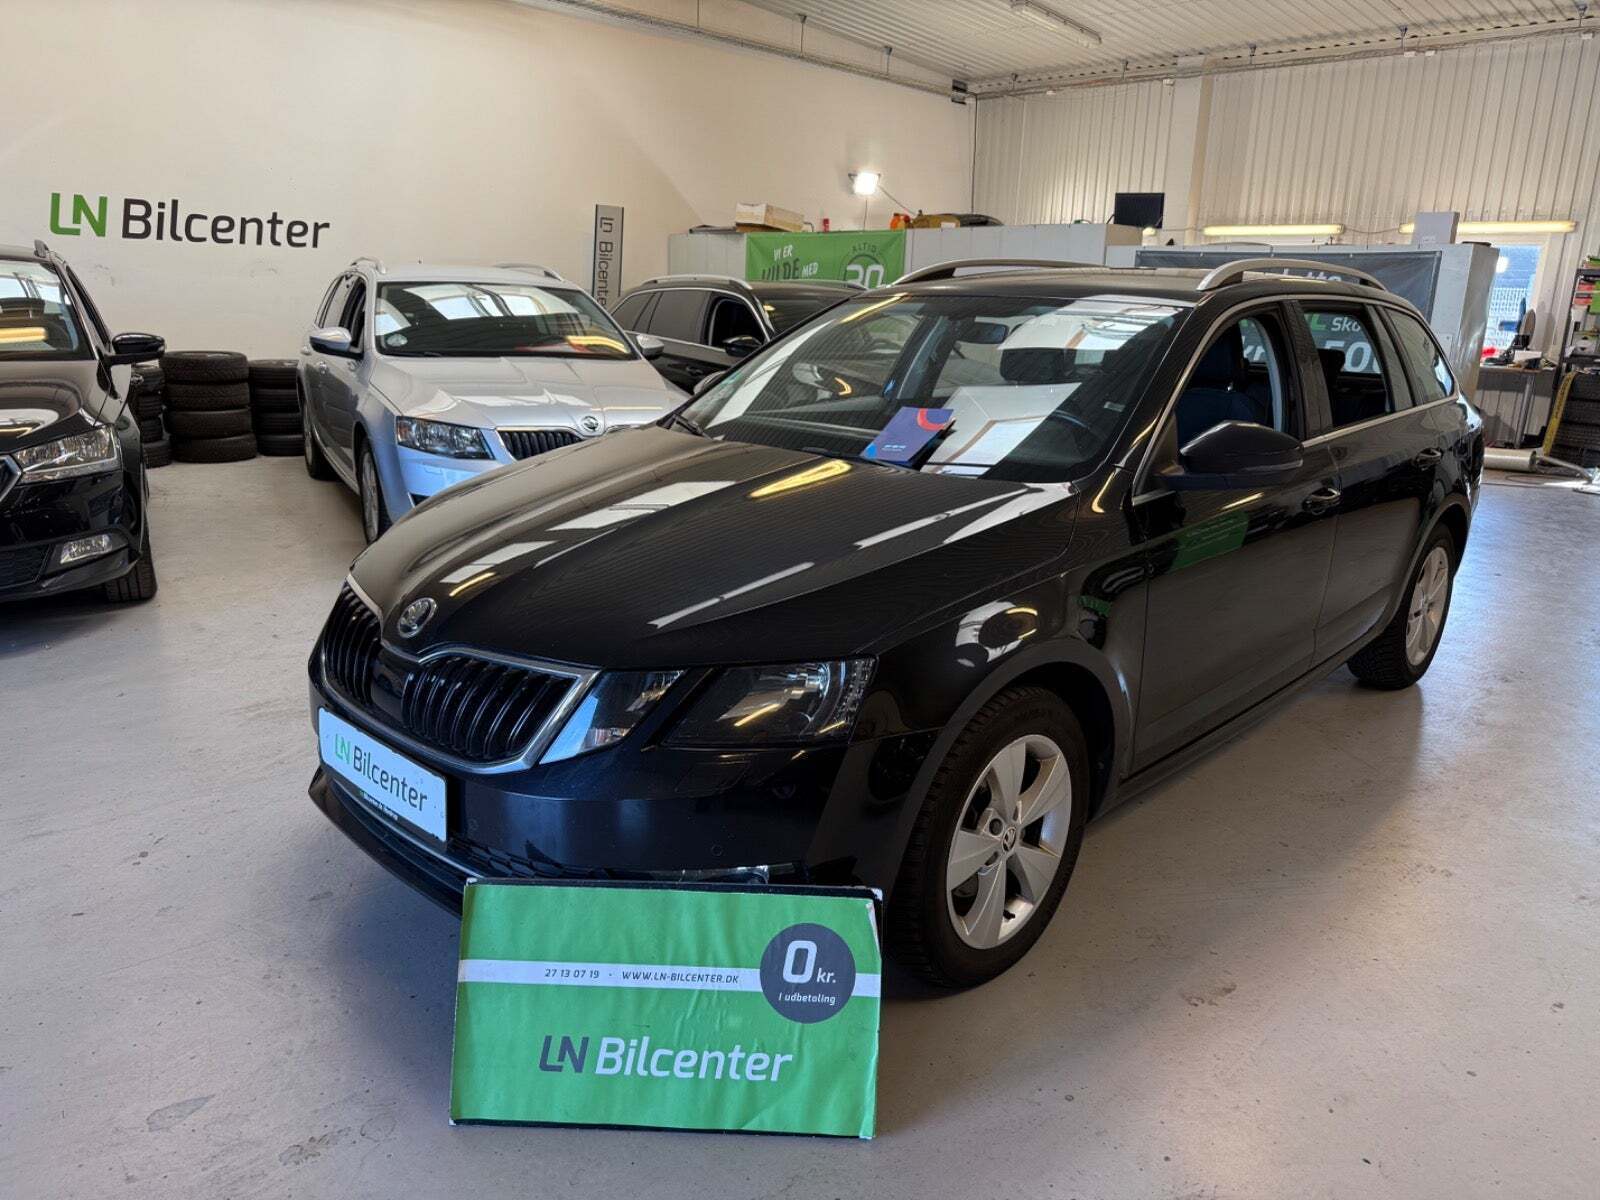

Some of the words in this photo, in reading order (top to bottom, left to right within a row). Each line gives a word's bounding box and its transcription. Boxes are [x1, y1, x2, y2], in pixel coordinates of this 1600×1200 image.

[50, 192, 108, 237] LN
[121, 198, 330, 248] Bilcenter
[597, 241, 613, 307] Bilcente
[335, 733, 350, 764] LN
[353, 745, 428, 812] Bilcenter
[544, 968, 557, 978] 27
[560, 969, 570, 978] 13
[573, 970, 585, 979] 07
[589, 970, 600, 979] 19
[622, 971, 739, 984] WWW.LN-BILCENTER.DK
[782, 940, 817, 983] 0
[816, 967, 836, 983] kr.
[785, 992, 836, 1006] udbetaling
[538, 1035, 589, 1073] LN
[594, 1036, 793, 1082] Bilcenter
